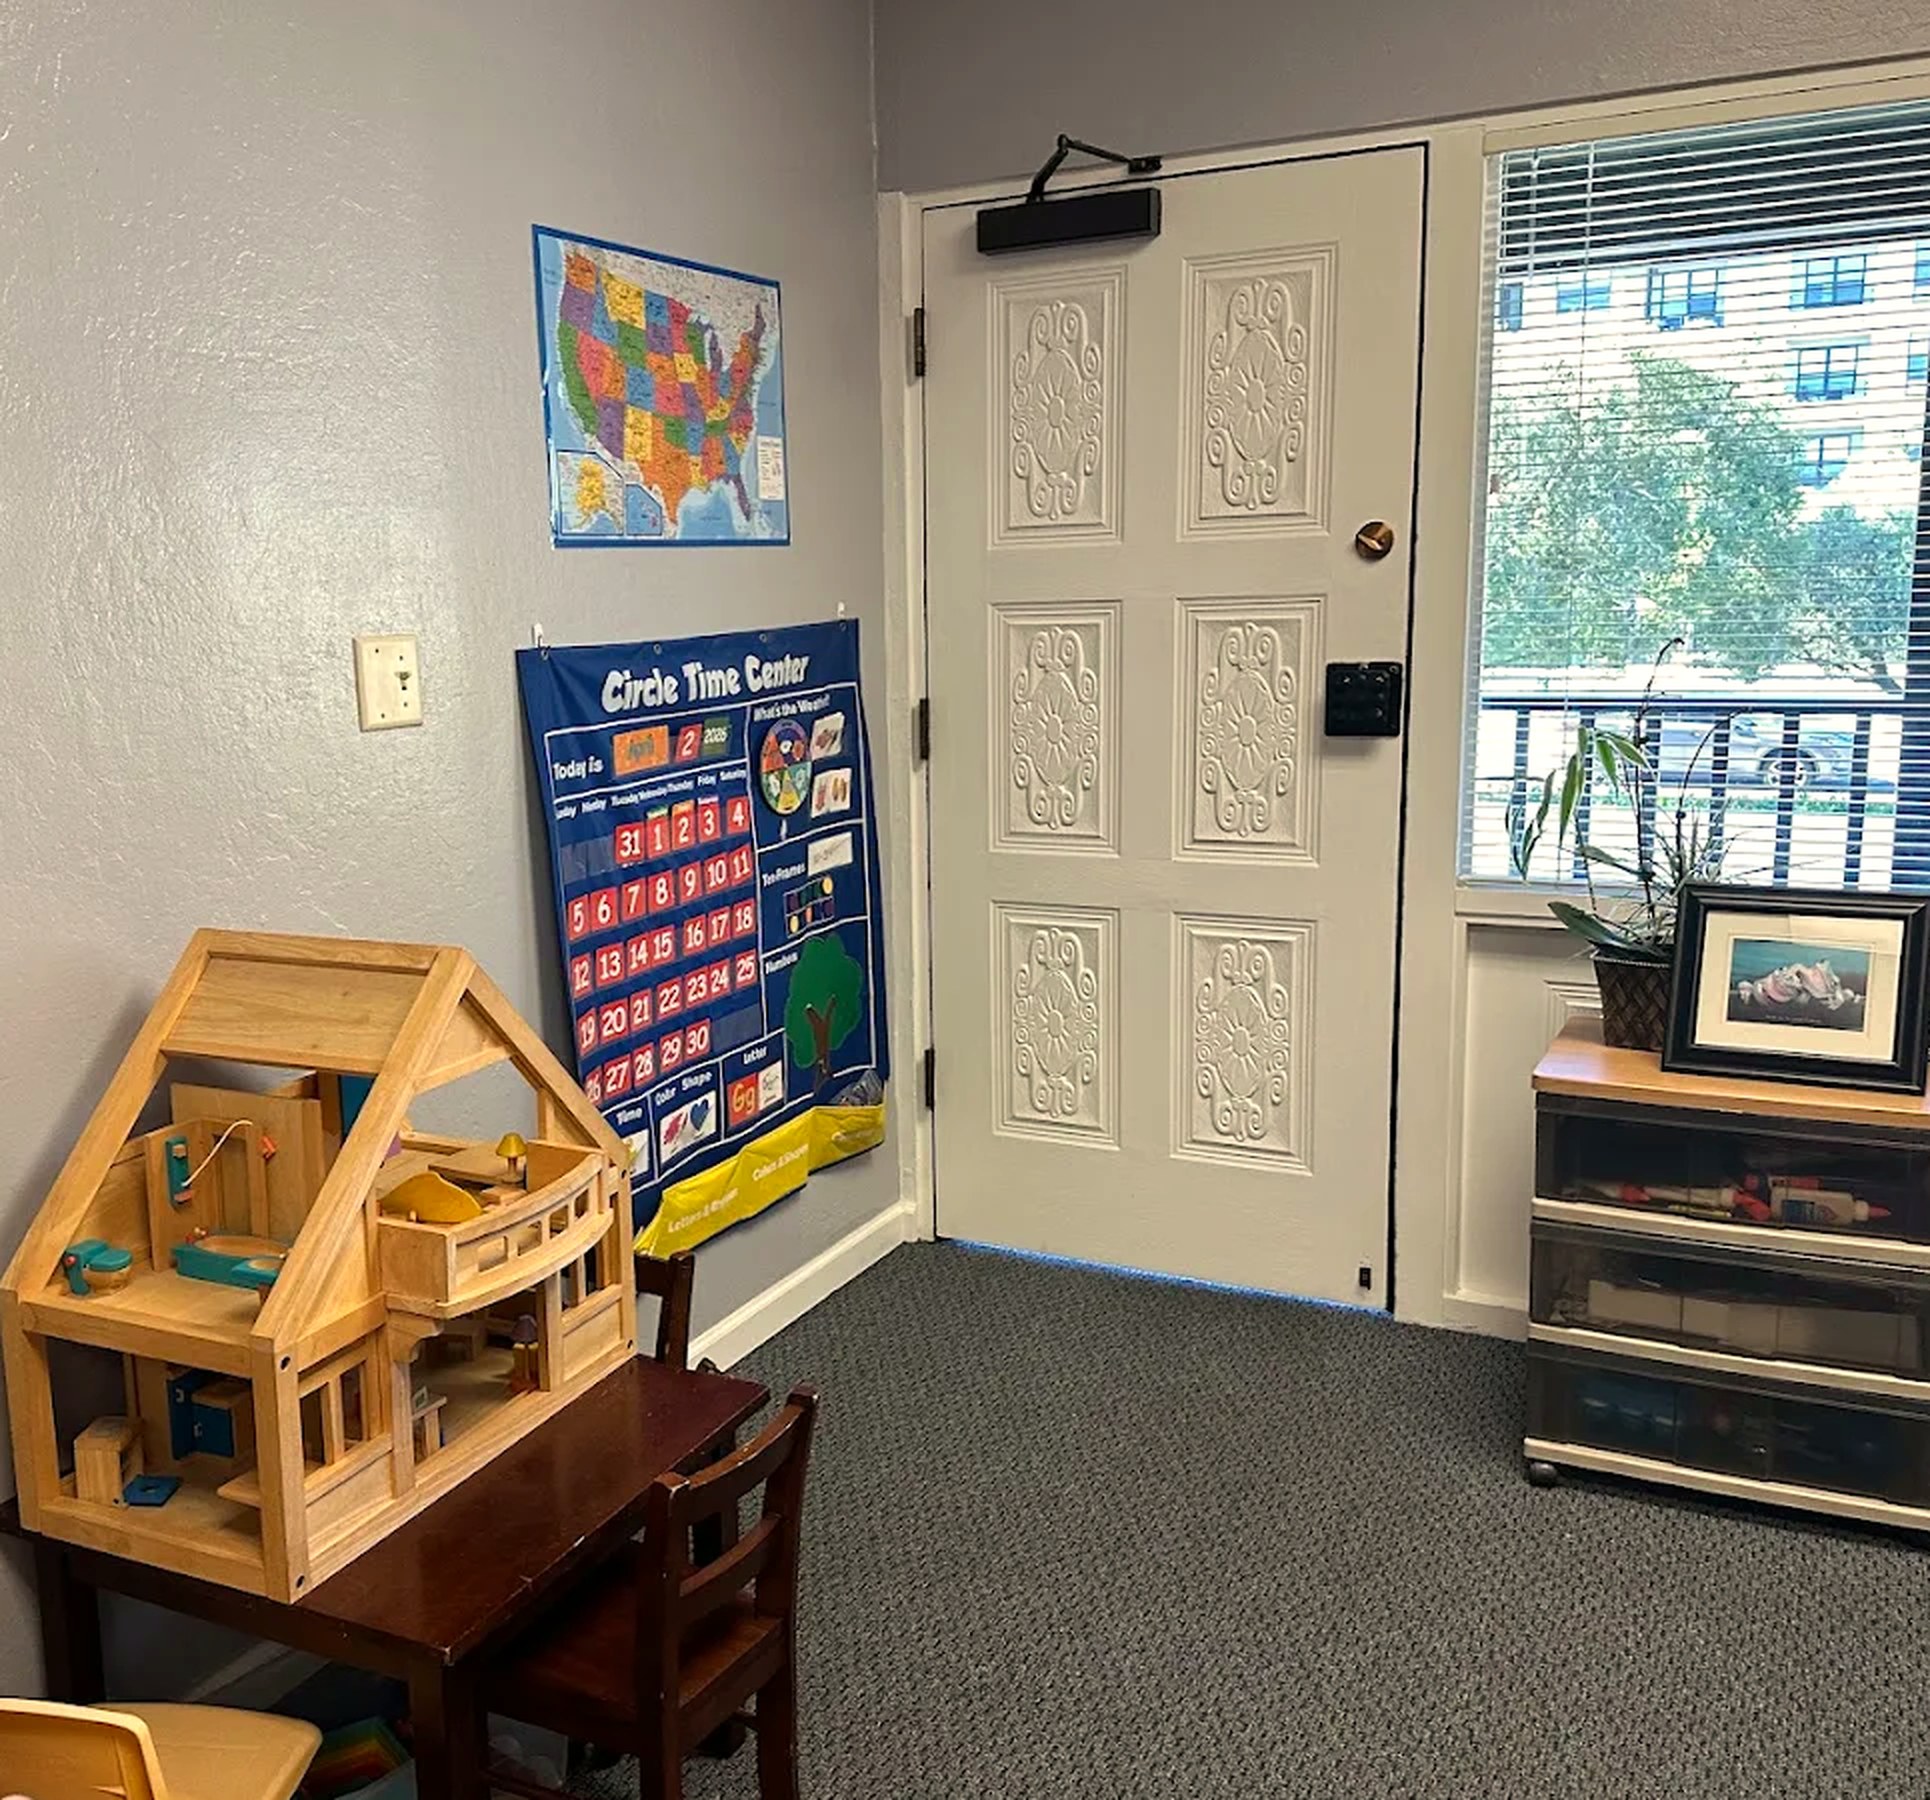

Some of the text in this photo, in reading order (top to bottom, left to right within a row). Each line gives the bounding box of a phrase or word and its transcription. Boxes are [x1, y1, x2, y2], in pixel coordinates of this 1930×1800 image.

[601, 653, 811, 713] Circle Time Center
[553, 761, 587, 780] Today
[588, 756, 604, 773] is
[682, 729, 696, 756] 2
[697, 774, 717, 787] Friday
[620, 829, 641, 858] 31
[654, 823, 663, 851] 1
[678, 817, 689, 843] 2
[703, 809, 715, 836] 3
[732, 801, 745, 827] 4
[573, 850, 750, 933] 5 6 7 8 9 10 11
[573, 905, 753, 991] 12 13 14 15 16 17 18
[580, 954, 755, 1049] 19 20 21 22 23 24 25
[605, 1061, 629, 1093] 27
[634, 1050, 653, 1080] 28
[662, 1036, 682, 1066] 29
[686, 1026, 709, 1055] 30
[743, 1046, 767, 1064] Letter
[655, 1071, 713, 1106] Color Shape
[732, 1083, 756, 1114] Gg
[616, 1107, 643, 1125] Time
